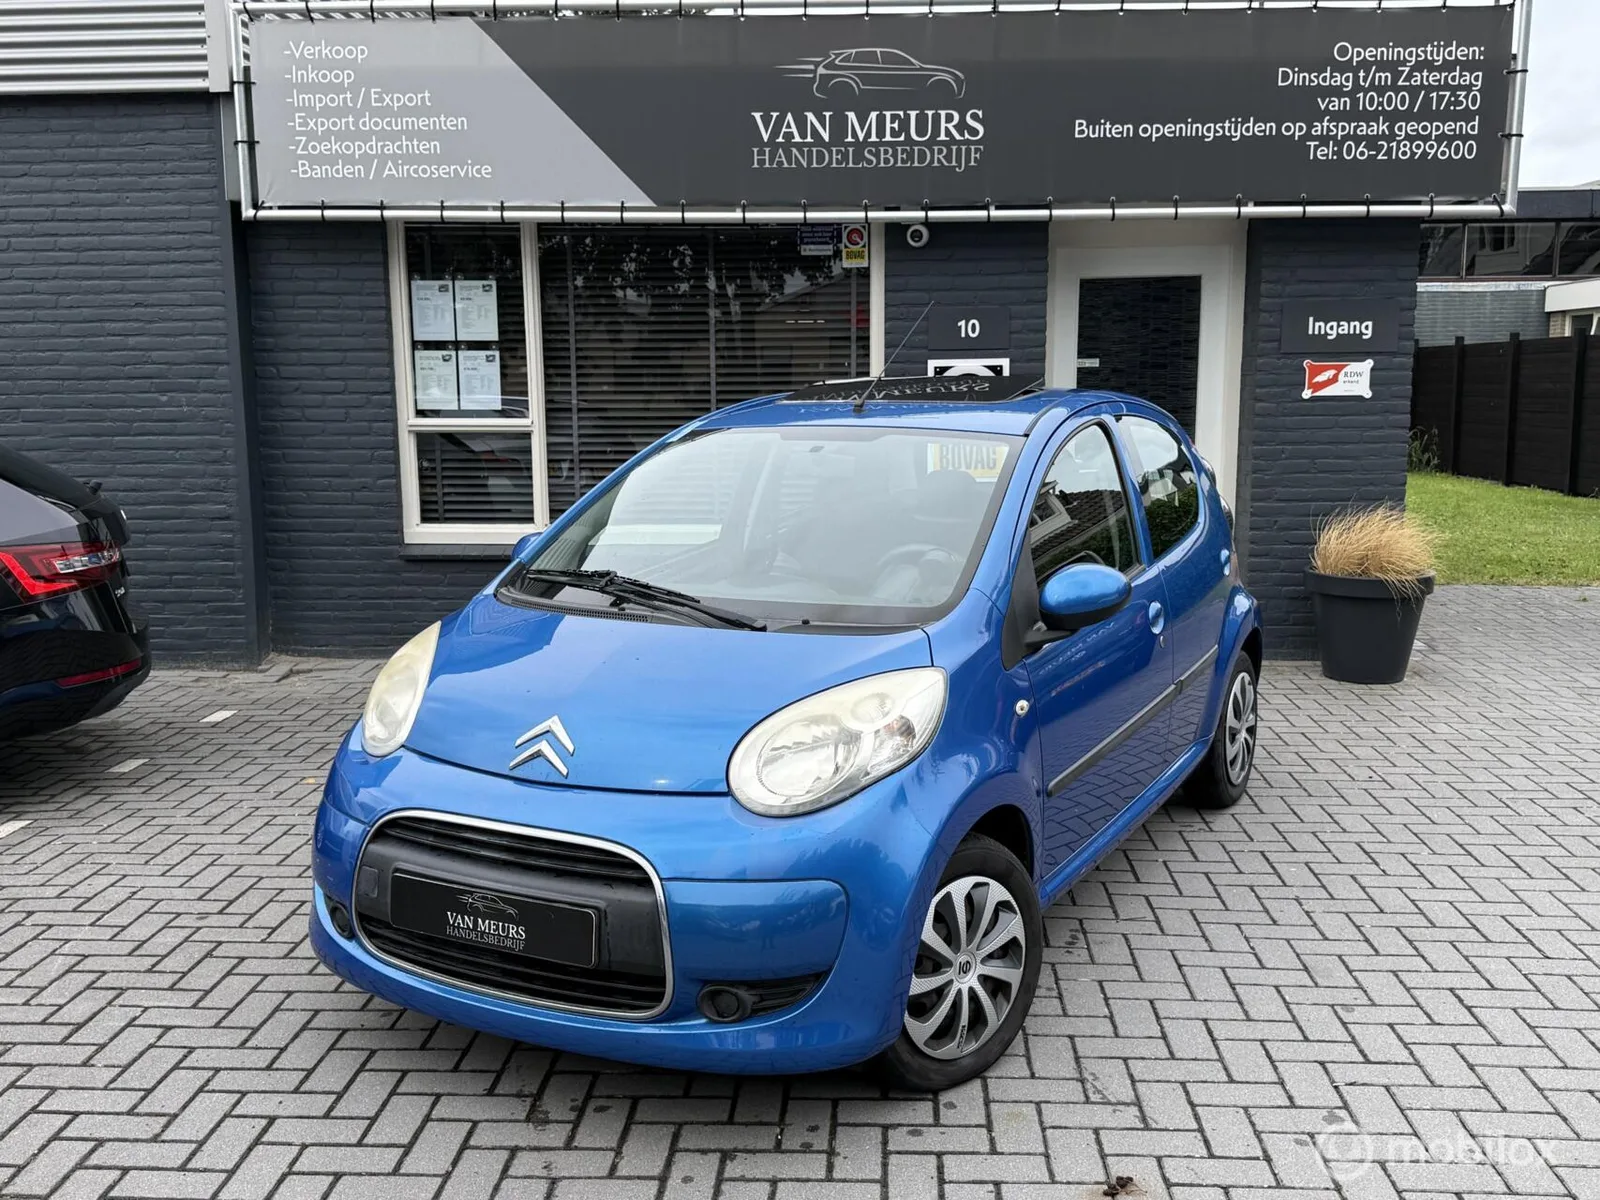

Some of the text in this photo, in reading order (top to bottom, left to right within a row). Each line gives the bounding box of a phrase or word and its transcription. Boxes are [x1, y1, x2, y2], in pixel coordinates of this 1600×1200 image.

[284, 40, 368, 62] -Verkoop
[1333, 41, 1485, 66] Openingstijden:
[285, 65, 355, 87] -Inkoop
[1277, 66, 1483, 91] Dinsdag t/m Zaterdag
[286, 87, 431, 110] -Import / Export
[1317, 91, 1481, 113] van 10:00 / 17:30
[288, 111, 468, 135] -Export documenten
[750, 109, 985, 143] VAN MEURS
[1074, 116, 1479, 142] Buiten openingstijden op afspraak geopend
[289, 135, 441, 158] -Zoekopdrachten
[1305, 140, 1477, 161] Tel: 06-21899600
[291, 158, 493, 181] -Banden / Aircoservice
[751, 145, 984, 173] HANDELSBEDRIJF
[845, 250, 866, 260] BOVAG
[957, 318, 981, 338] 10
[1308, 316, 1373, 340] Ingang
[1343, 370, 1364, 378] RDW
[940, 444, 997, 471] BOVAG
[446, 911, 526, 940] VAN MEURS
[446, 925, 526, 952] HANDELSBEDRIJF
